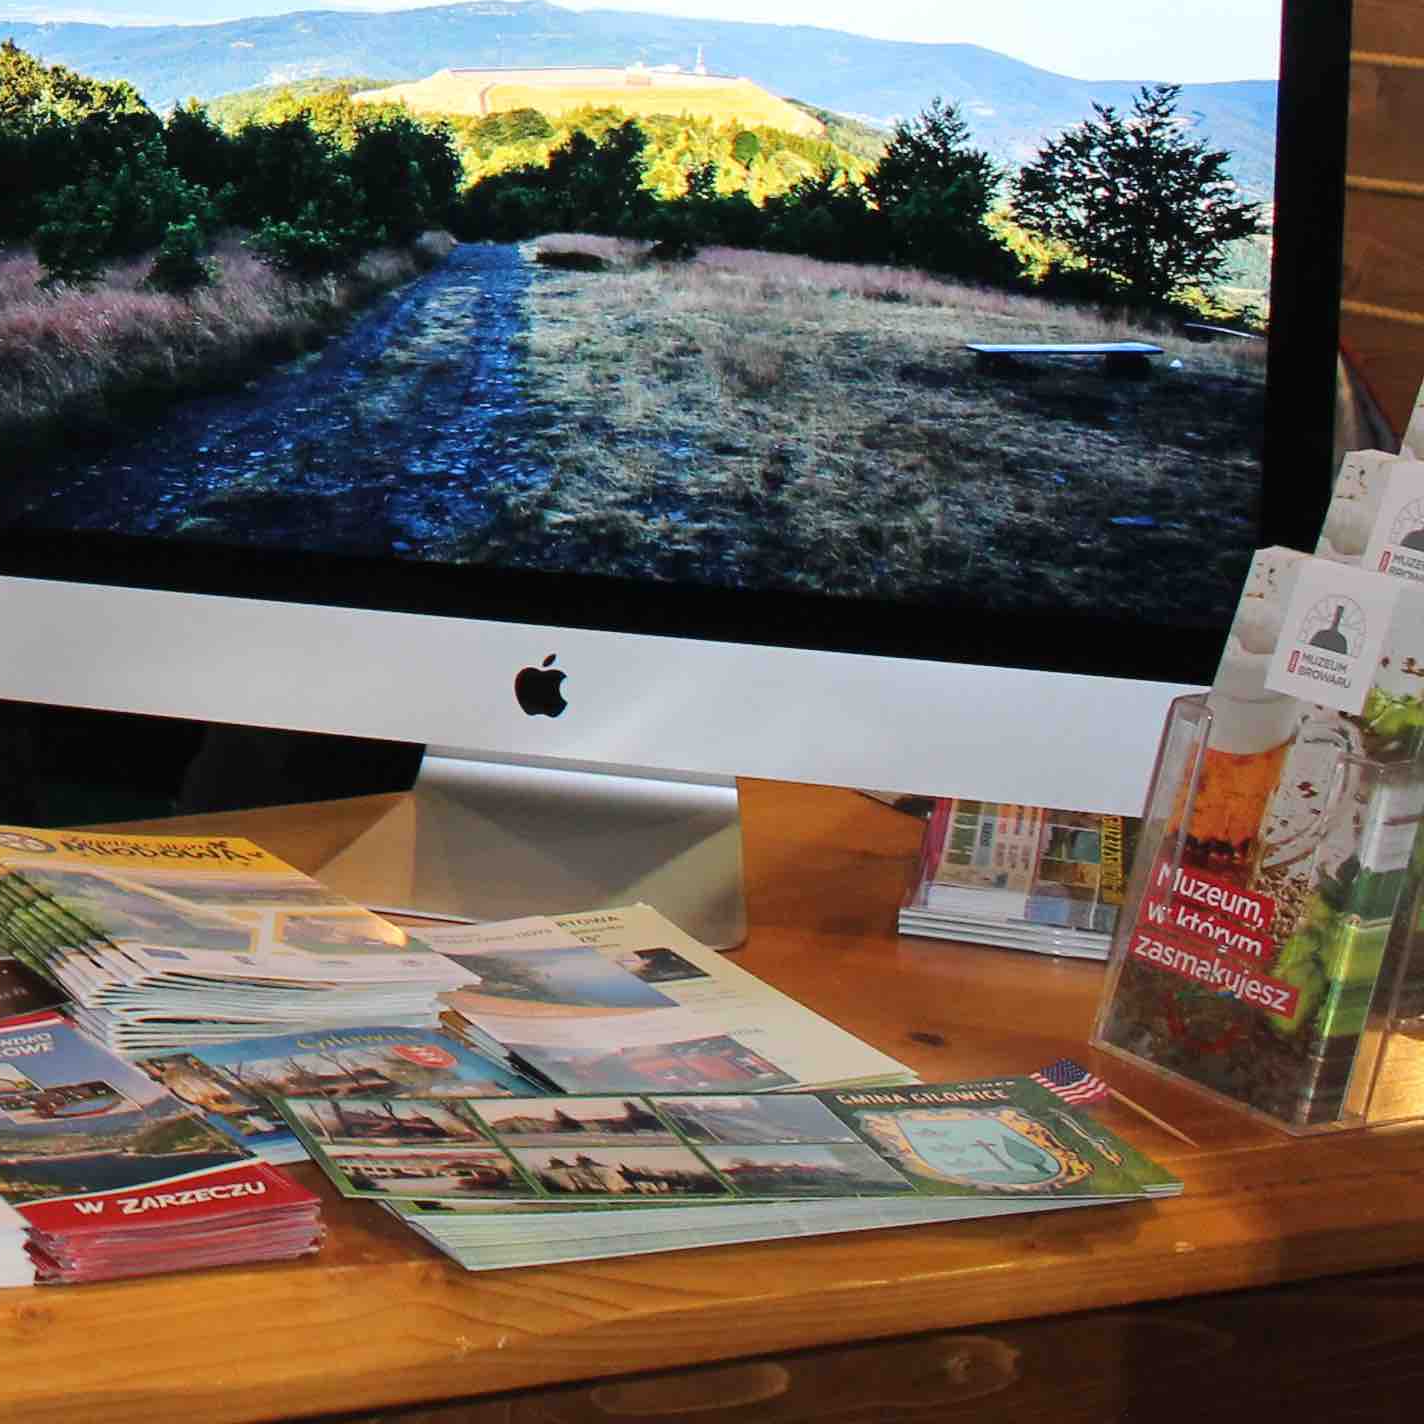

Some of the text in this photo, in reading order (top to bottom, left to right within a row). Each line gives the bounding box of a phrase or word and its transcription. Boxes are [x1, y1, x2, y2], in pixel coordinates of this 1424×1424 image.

[1156, 863, 1264, 928] Muzeum,
[1176, 905, 1262, 957] którym
[1134, 935, 1291, 1012] zasmakujesz
[835, 1091, 907, 1106] GMINA
[73, 1181, 267, 1216] W ZARZECZU
